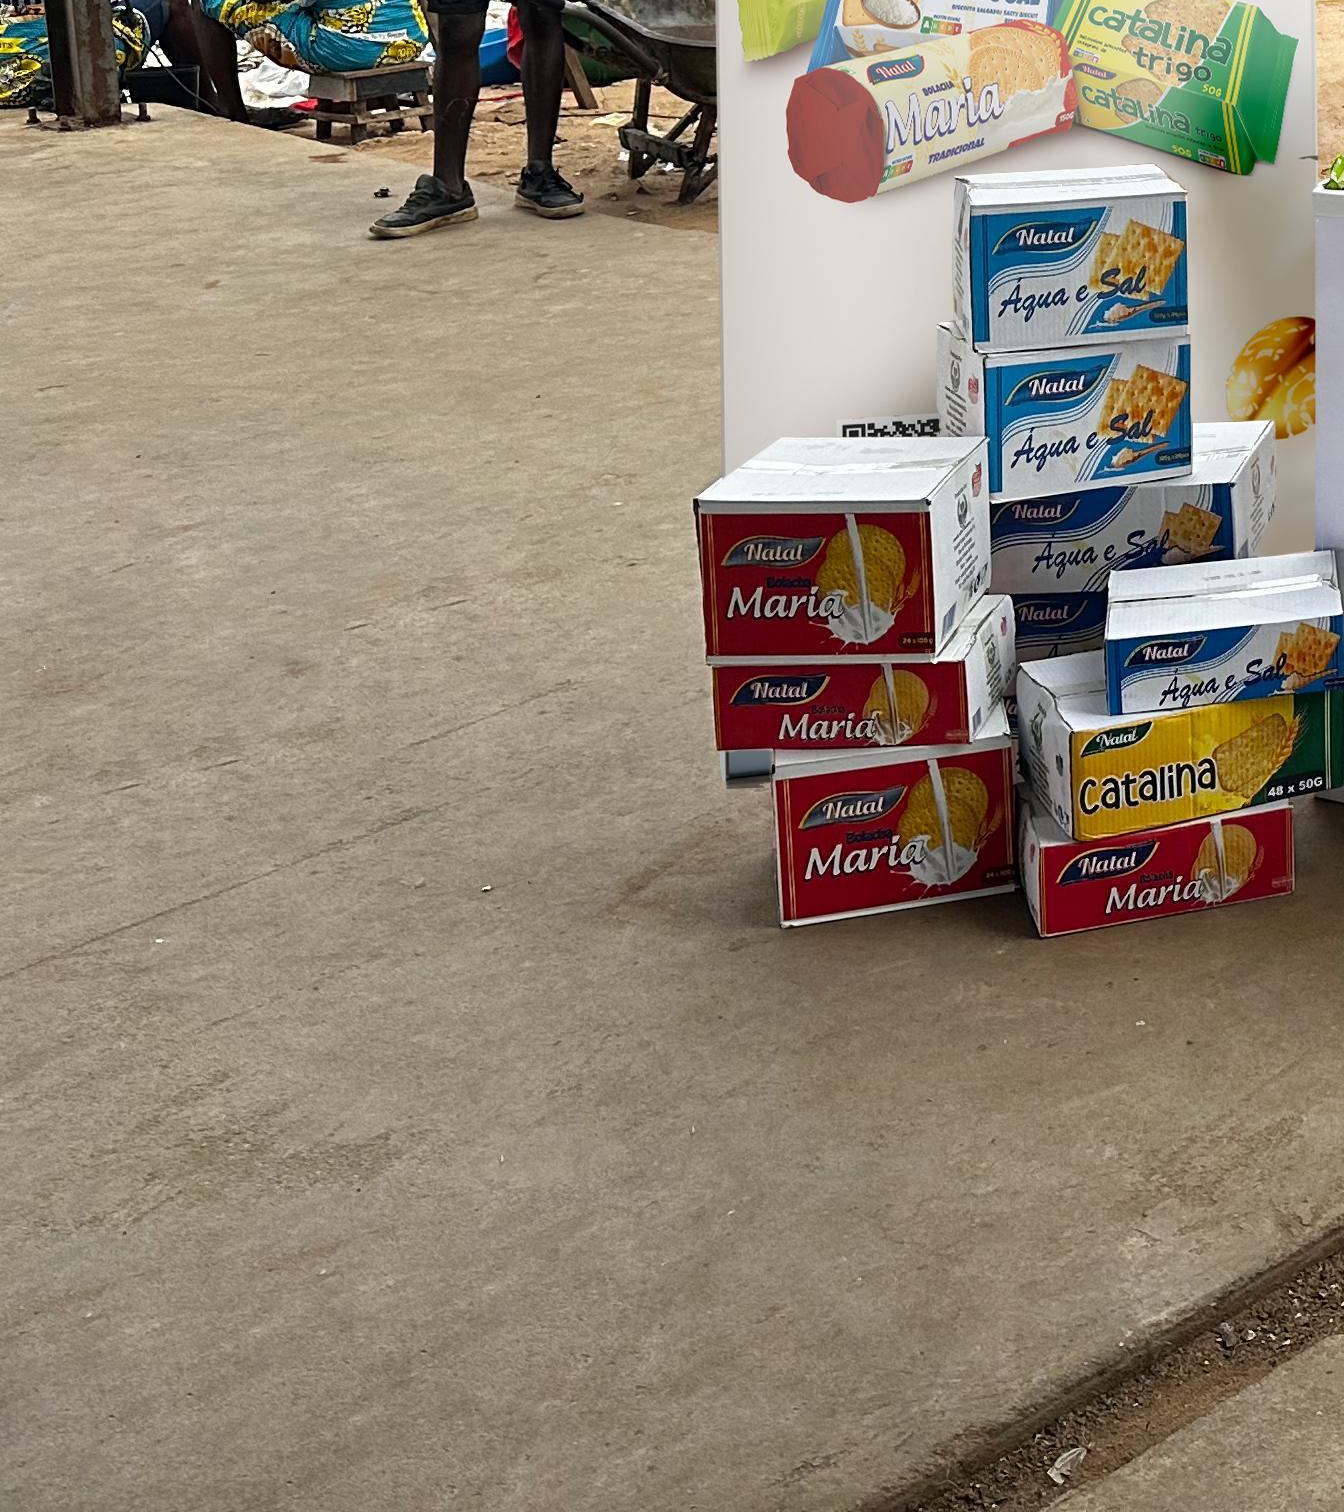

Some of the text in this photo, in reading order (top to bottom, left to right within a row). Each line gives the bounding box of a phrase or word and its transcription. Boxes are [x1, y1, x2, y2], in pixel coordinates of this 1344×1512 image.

[875, 61, 915, 81] Natal
[1135, 46, 1212, 83] trigo
[922, 81, 954, 96] BOLACHA
[885, 76, 1005, 154] Maria
[928, 138, 985, 164] TRADICIONAL
[1016, 226, 1075, 246] Natal
[1076, 285, 1087, 302] e
[1097, 267, 1147, 299] Sal
[1029, 373, 1084, 394] Natal
[1086, 433, 1097, 451] e
[1107, 412, 1153, 443] Sal
[1012, 502, 1063, 520] Natal
[743, 540, 803, 562] Natal
[1104, 545, 1116, 560] e
[1124, 529, 1170, 559] Sal
[726, 586, 847, 620] Maria
[1018, 604, 1070, 621] Natal
[1142, 643, 1190, 662] Natal
[1225, 675, 1236, 687] e
[1245, 653, 1288, 685] Sal
[750, 679, 809, 700] Natal
[778, 712, 878, 742] Maria
[1096, 729, 1138, 746] Natal
[1268, 776, 1323, 797] 48 50G
[822, 795, 885, 820] Natal
[805, 834, 930, 881] Maria
[1079, 852, 1137, 874] Natal
[1105, 876, 1205, 915] Maria
